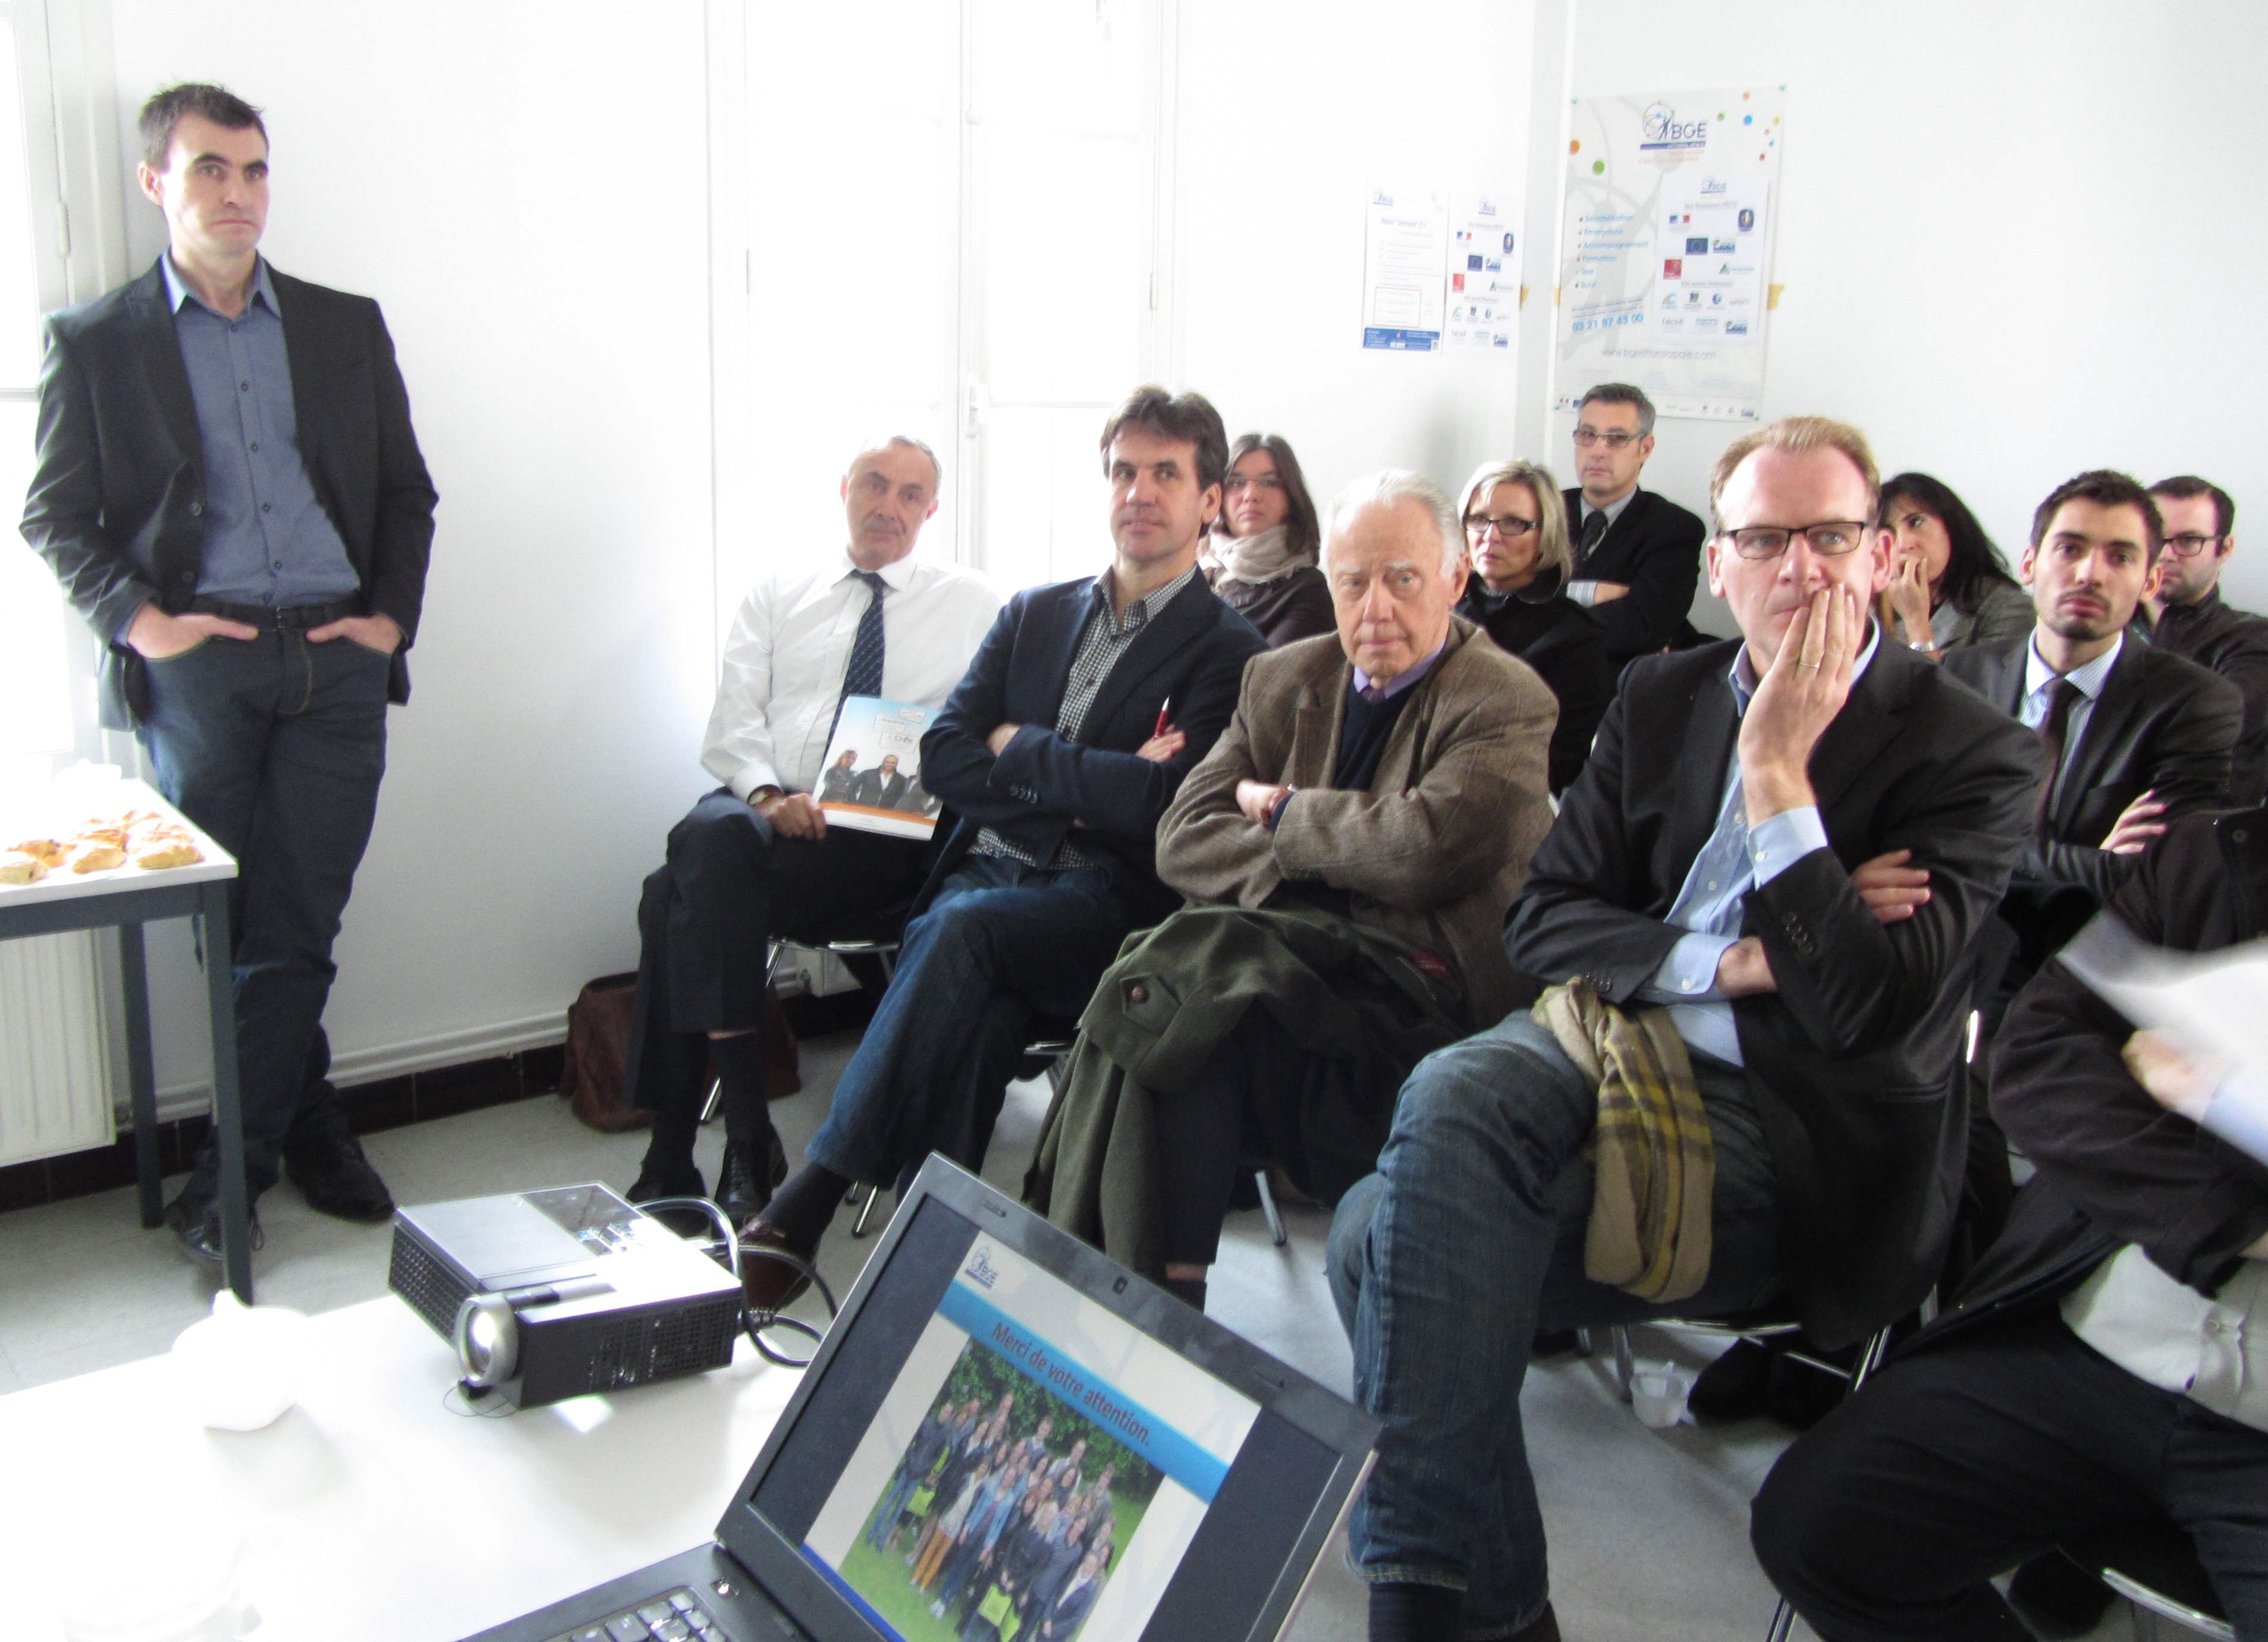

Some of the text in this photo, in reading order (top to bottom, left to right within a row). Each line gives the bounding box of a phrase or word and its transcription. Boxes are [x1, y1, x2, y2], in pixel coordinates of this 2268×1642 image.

[1671, 122, 1707, 140] BGE
[1587, 319, 1598, 329] 21
[1631, 313, 1644, 323] 00
[992, 1322, 1150, 1446] Merci de votre attention.
